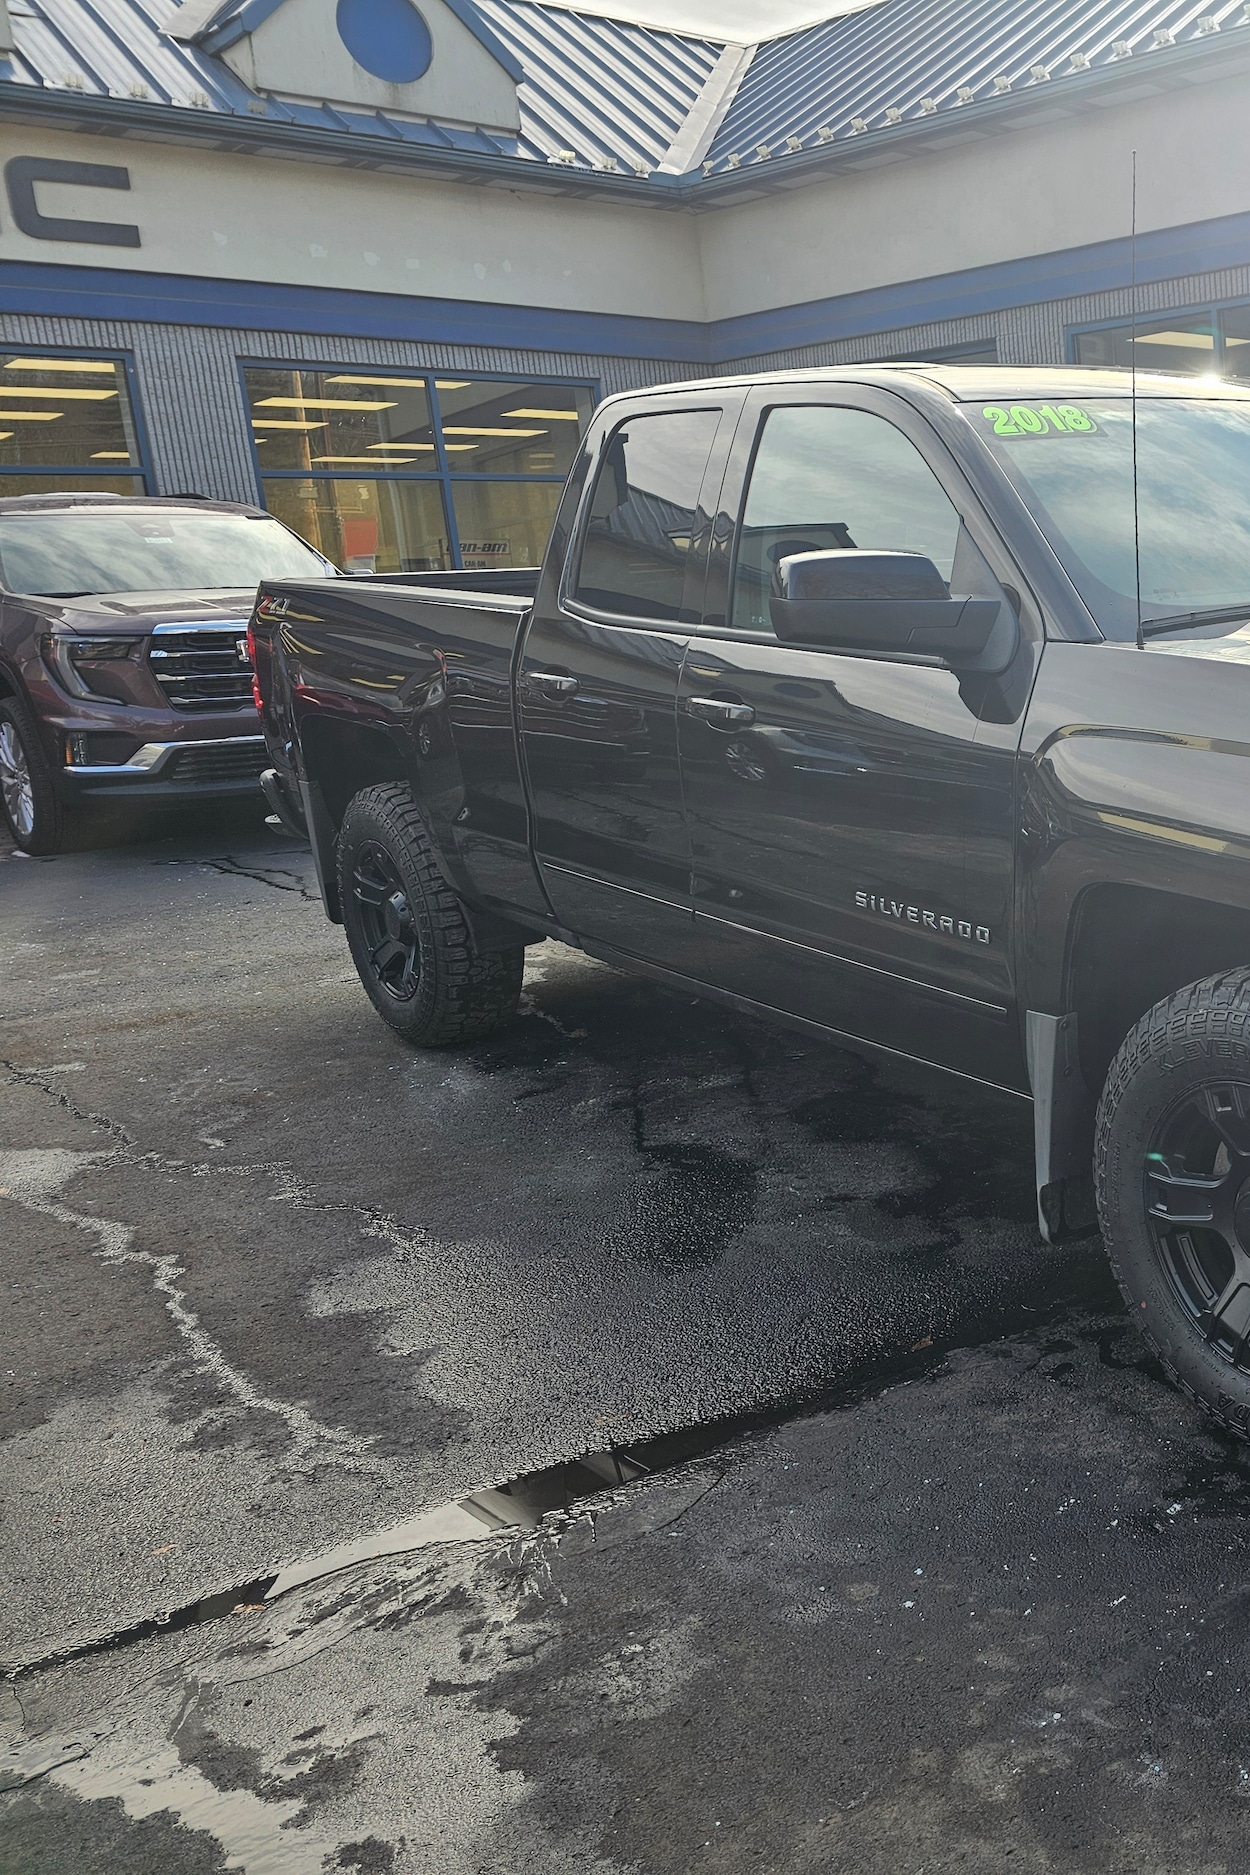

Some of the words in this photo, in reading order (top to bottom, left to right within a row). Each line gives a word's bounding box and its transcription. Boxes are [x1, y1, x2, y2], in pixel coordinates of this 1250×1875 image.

[0, 155, 142, 249] C
[982, 404, 1098, 437] 2018
[447, 543, 508, 553] an-am
[855, 891, 992, 945] SILVERADO
